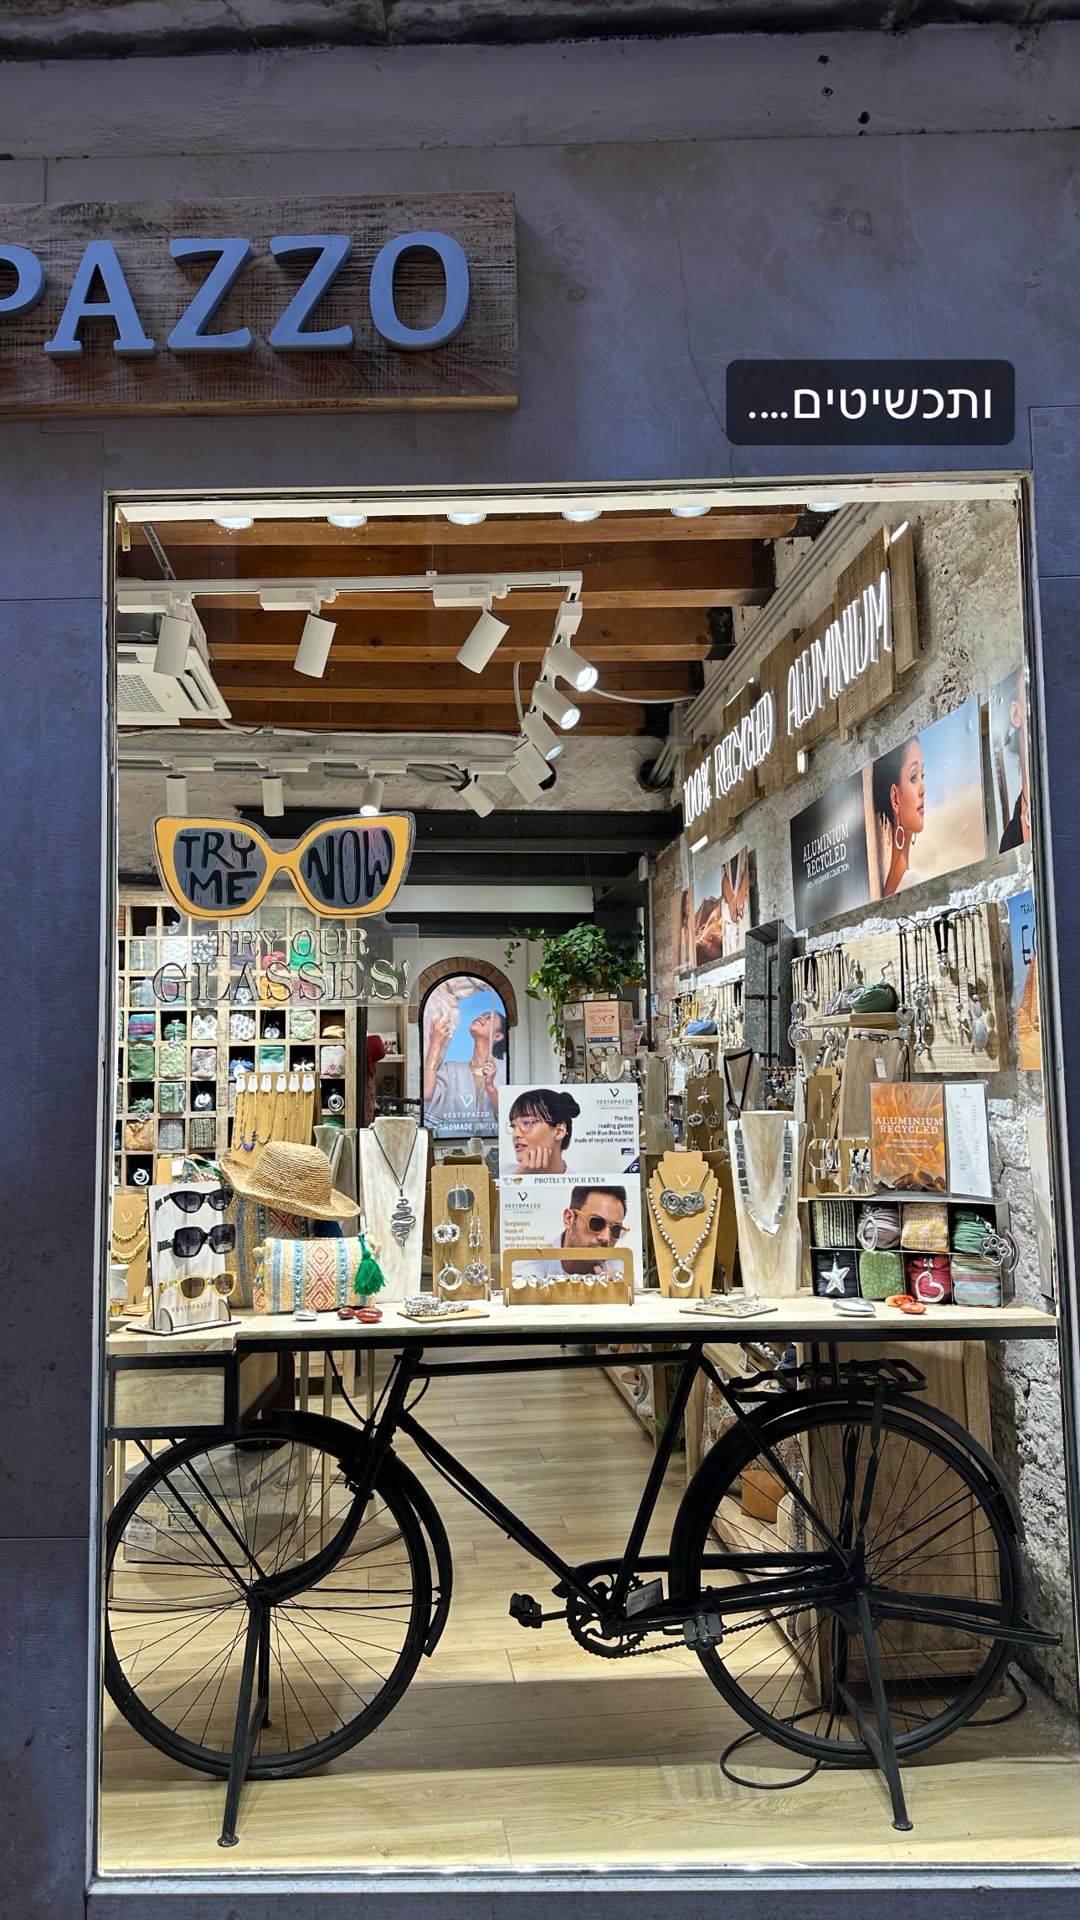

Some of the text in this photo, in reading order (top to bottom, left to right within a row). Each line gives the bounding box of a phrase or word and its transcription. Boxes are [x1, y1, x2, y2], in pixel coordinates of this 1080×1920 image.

[683, 568, 892, 828] 100% RECYCLED ALUMINIUM
[179, 832, 256, 870] TRY
[803, 820, 849, 863] ALUMINIUM
[307, 829, 394, 905] NOW
[806, 843, 847, 879] RECYCLED
[189, 869, 257, 906] ME
[207, 927, 370, 957] TRY OUR
[152, 958, 411, 1004] GLASSES!
[474, 1121, 498, 1131] JEWELRY
[875, 1116, 943, 1126] ALUMINIUM
[880, 1124, 939, 1135] RECYCLED
[594, 1137, 614, 1145] recycled
[534, 1176, 564, 1184] PROTECT
[171, 1302, 212, 1313] VESTOPAZZO
